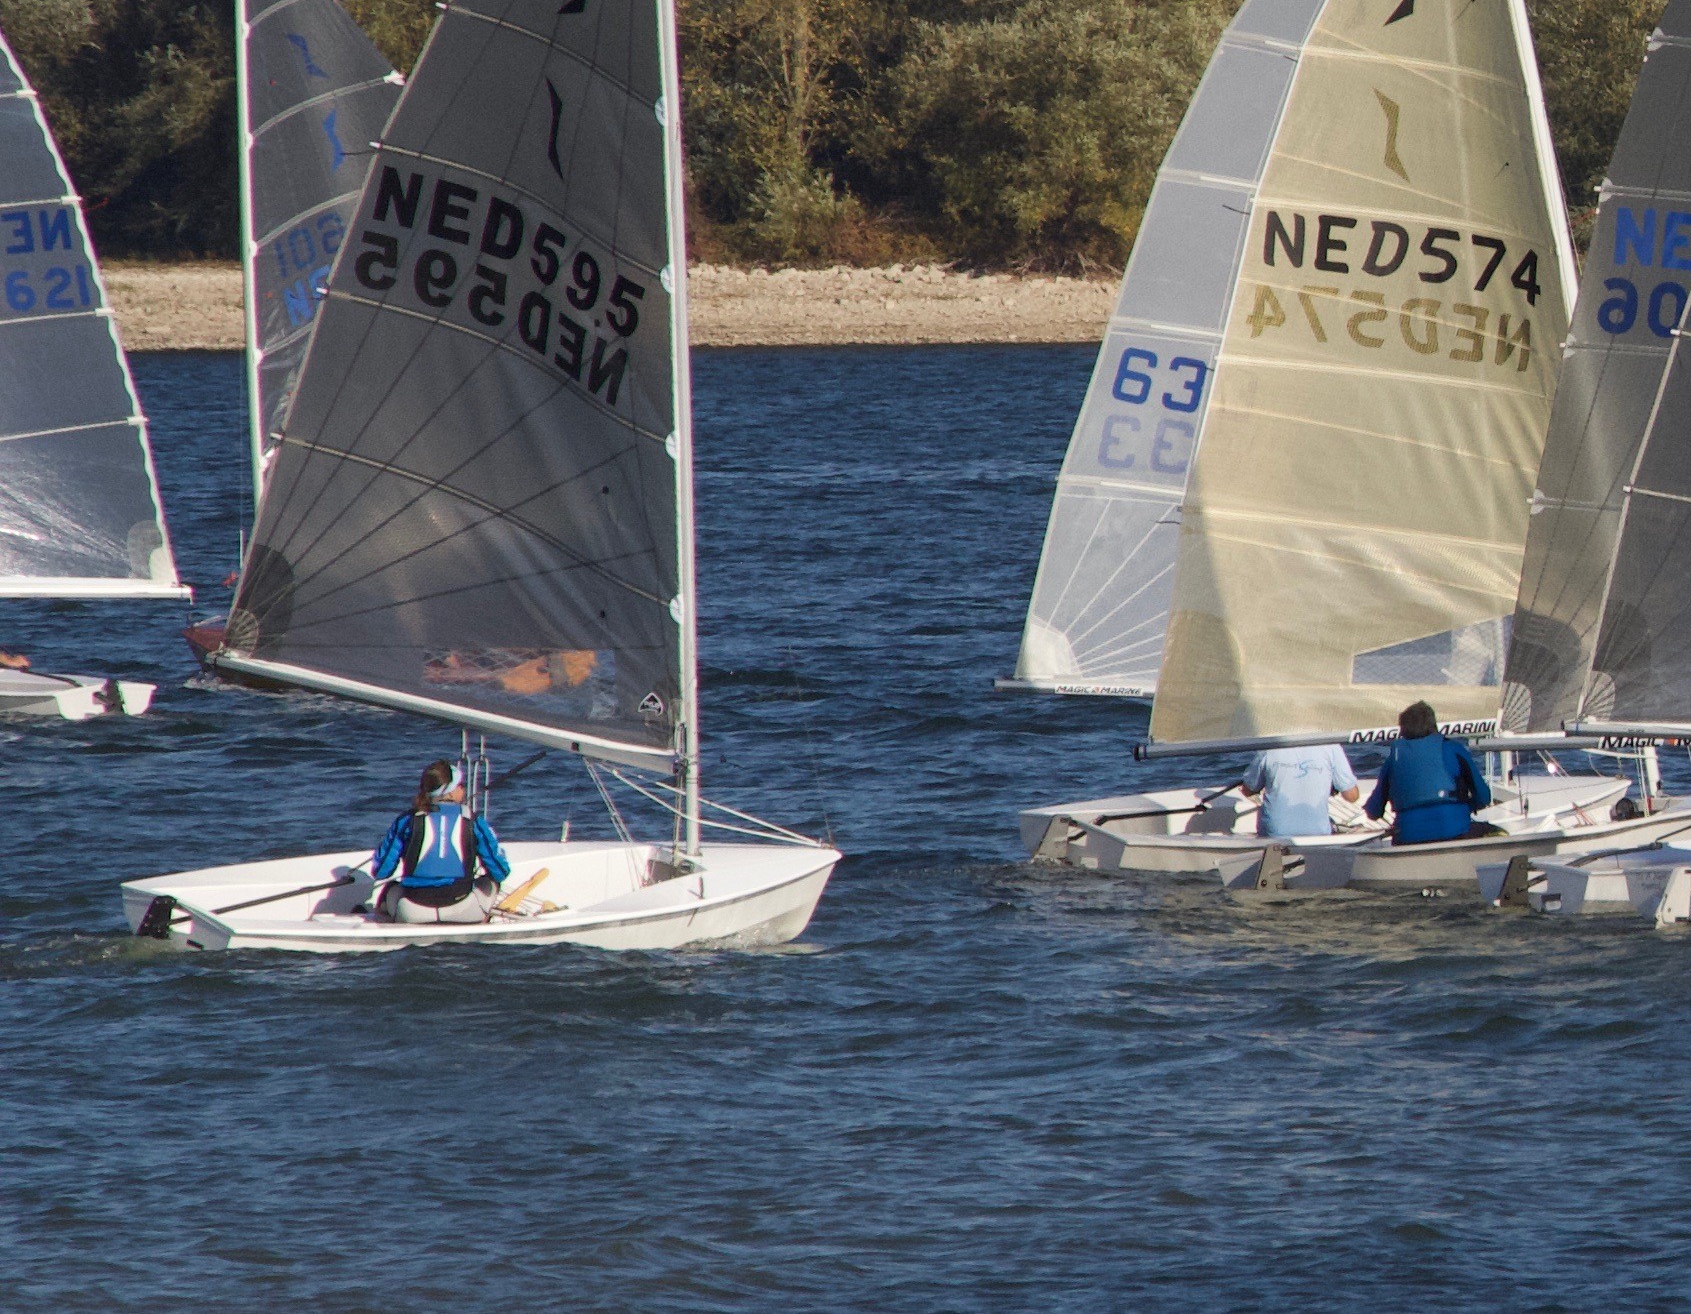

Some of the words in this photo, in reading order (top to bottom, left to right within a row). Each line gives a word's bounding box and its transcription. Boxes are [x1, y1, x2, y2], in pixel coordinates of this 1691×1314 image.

[372, 165, 646, 338] NED595
[1262, 211, 1542, 306] NED574
[1112, 347, 1207, 414] 63
[1352, 729, 1400, 743] MAG
[1602, 736, 1661, 749] MAGIC
